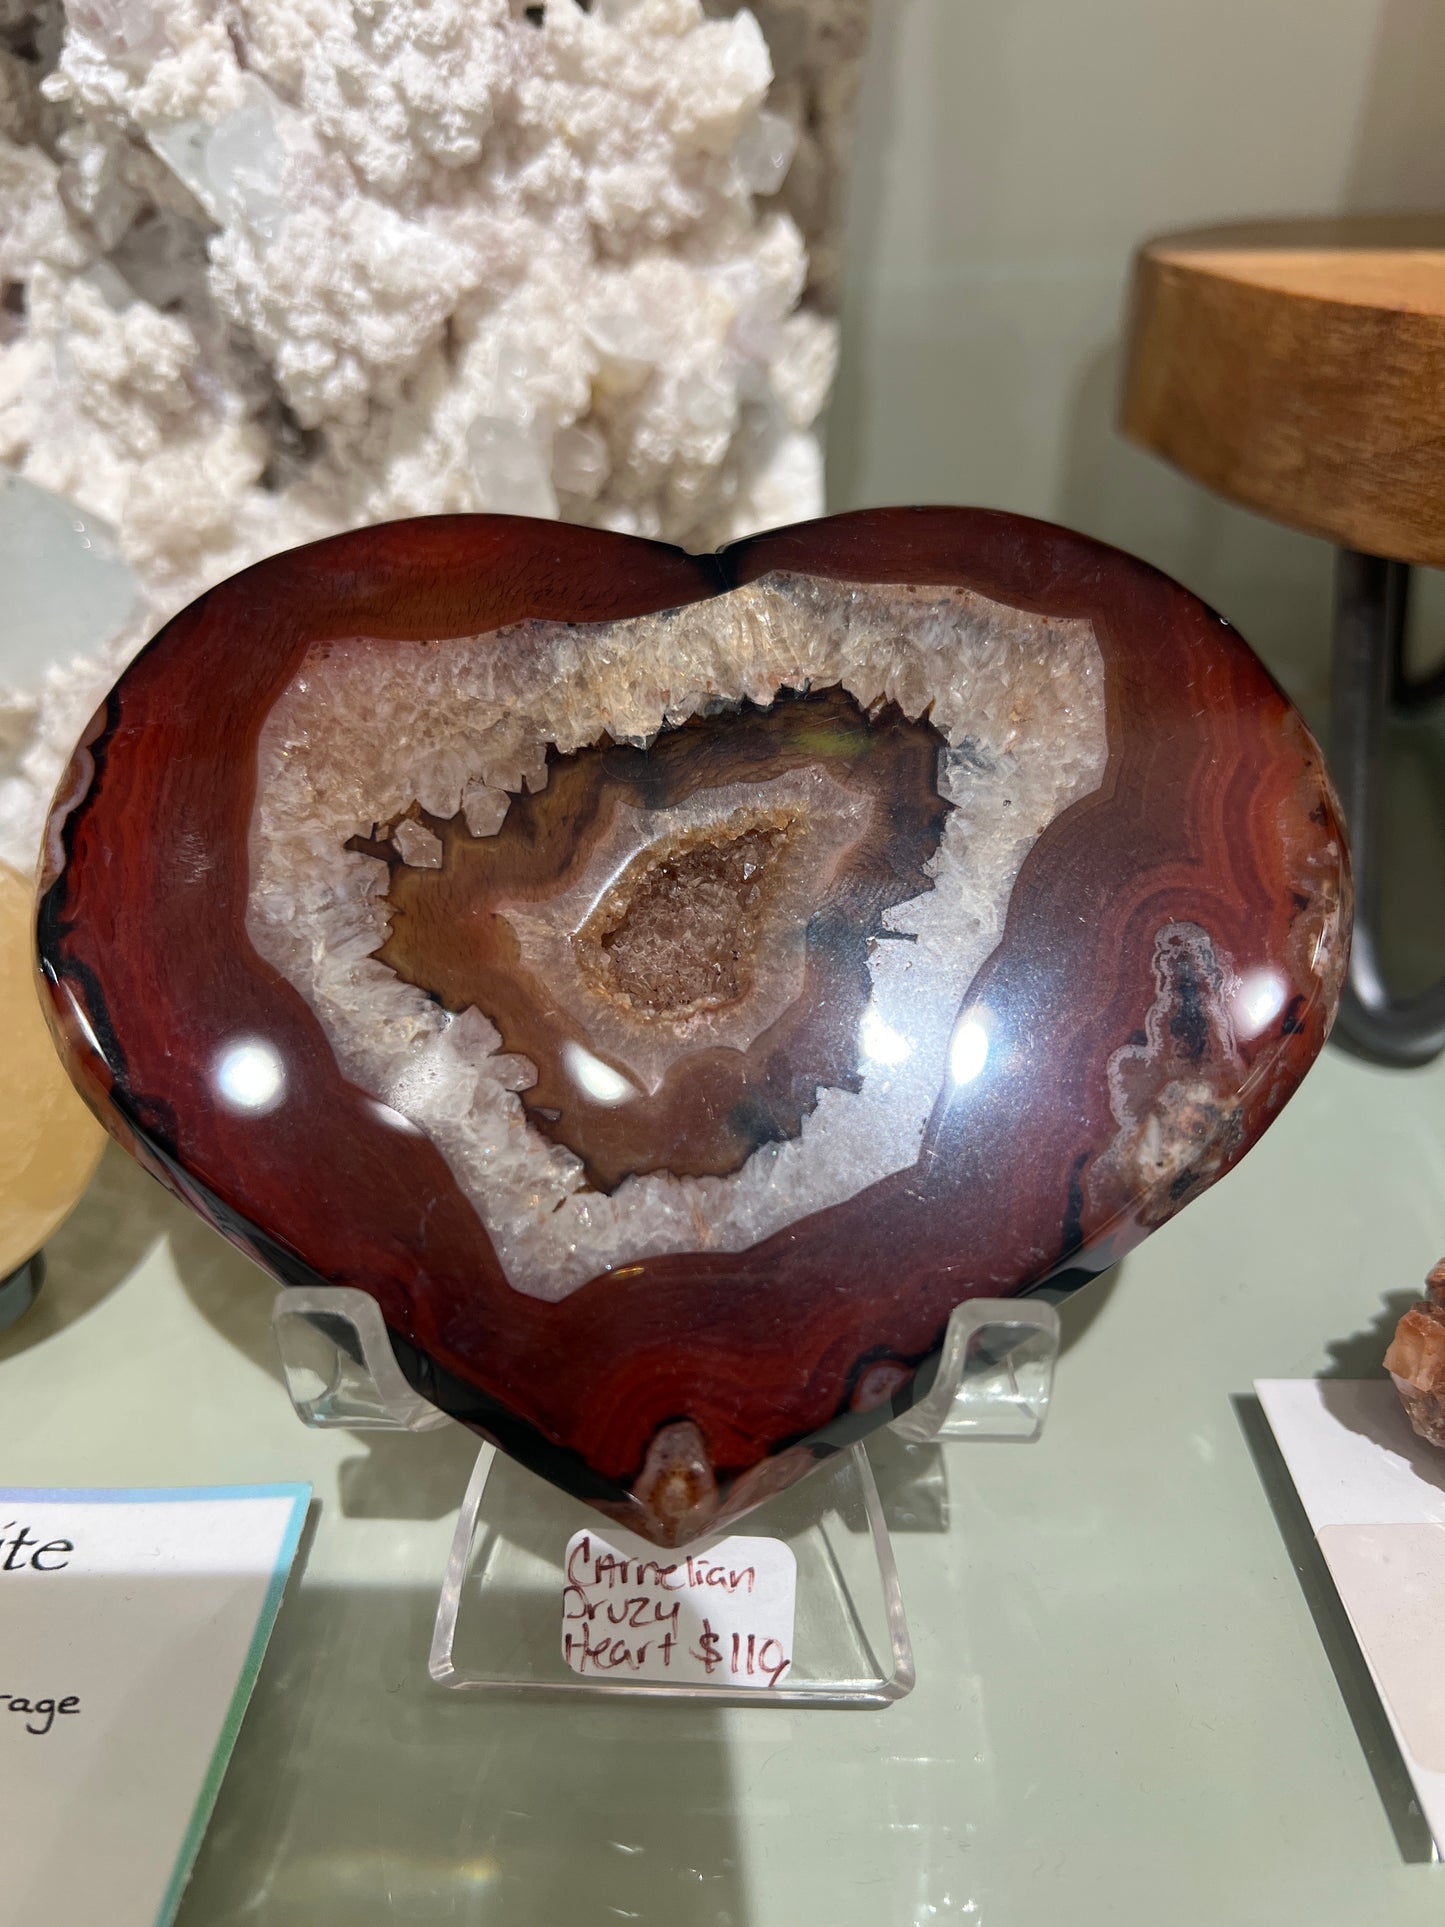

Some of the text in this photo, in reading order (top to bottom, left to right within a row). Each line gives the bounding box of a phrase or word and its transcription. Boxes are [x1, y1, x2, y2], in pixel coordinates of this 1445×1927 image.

[564, 1586, 680, 1639] Druzy
[565, 1618, 791, 1687] Heart $119
